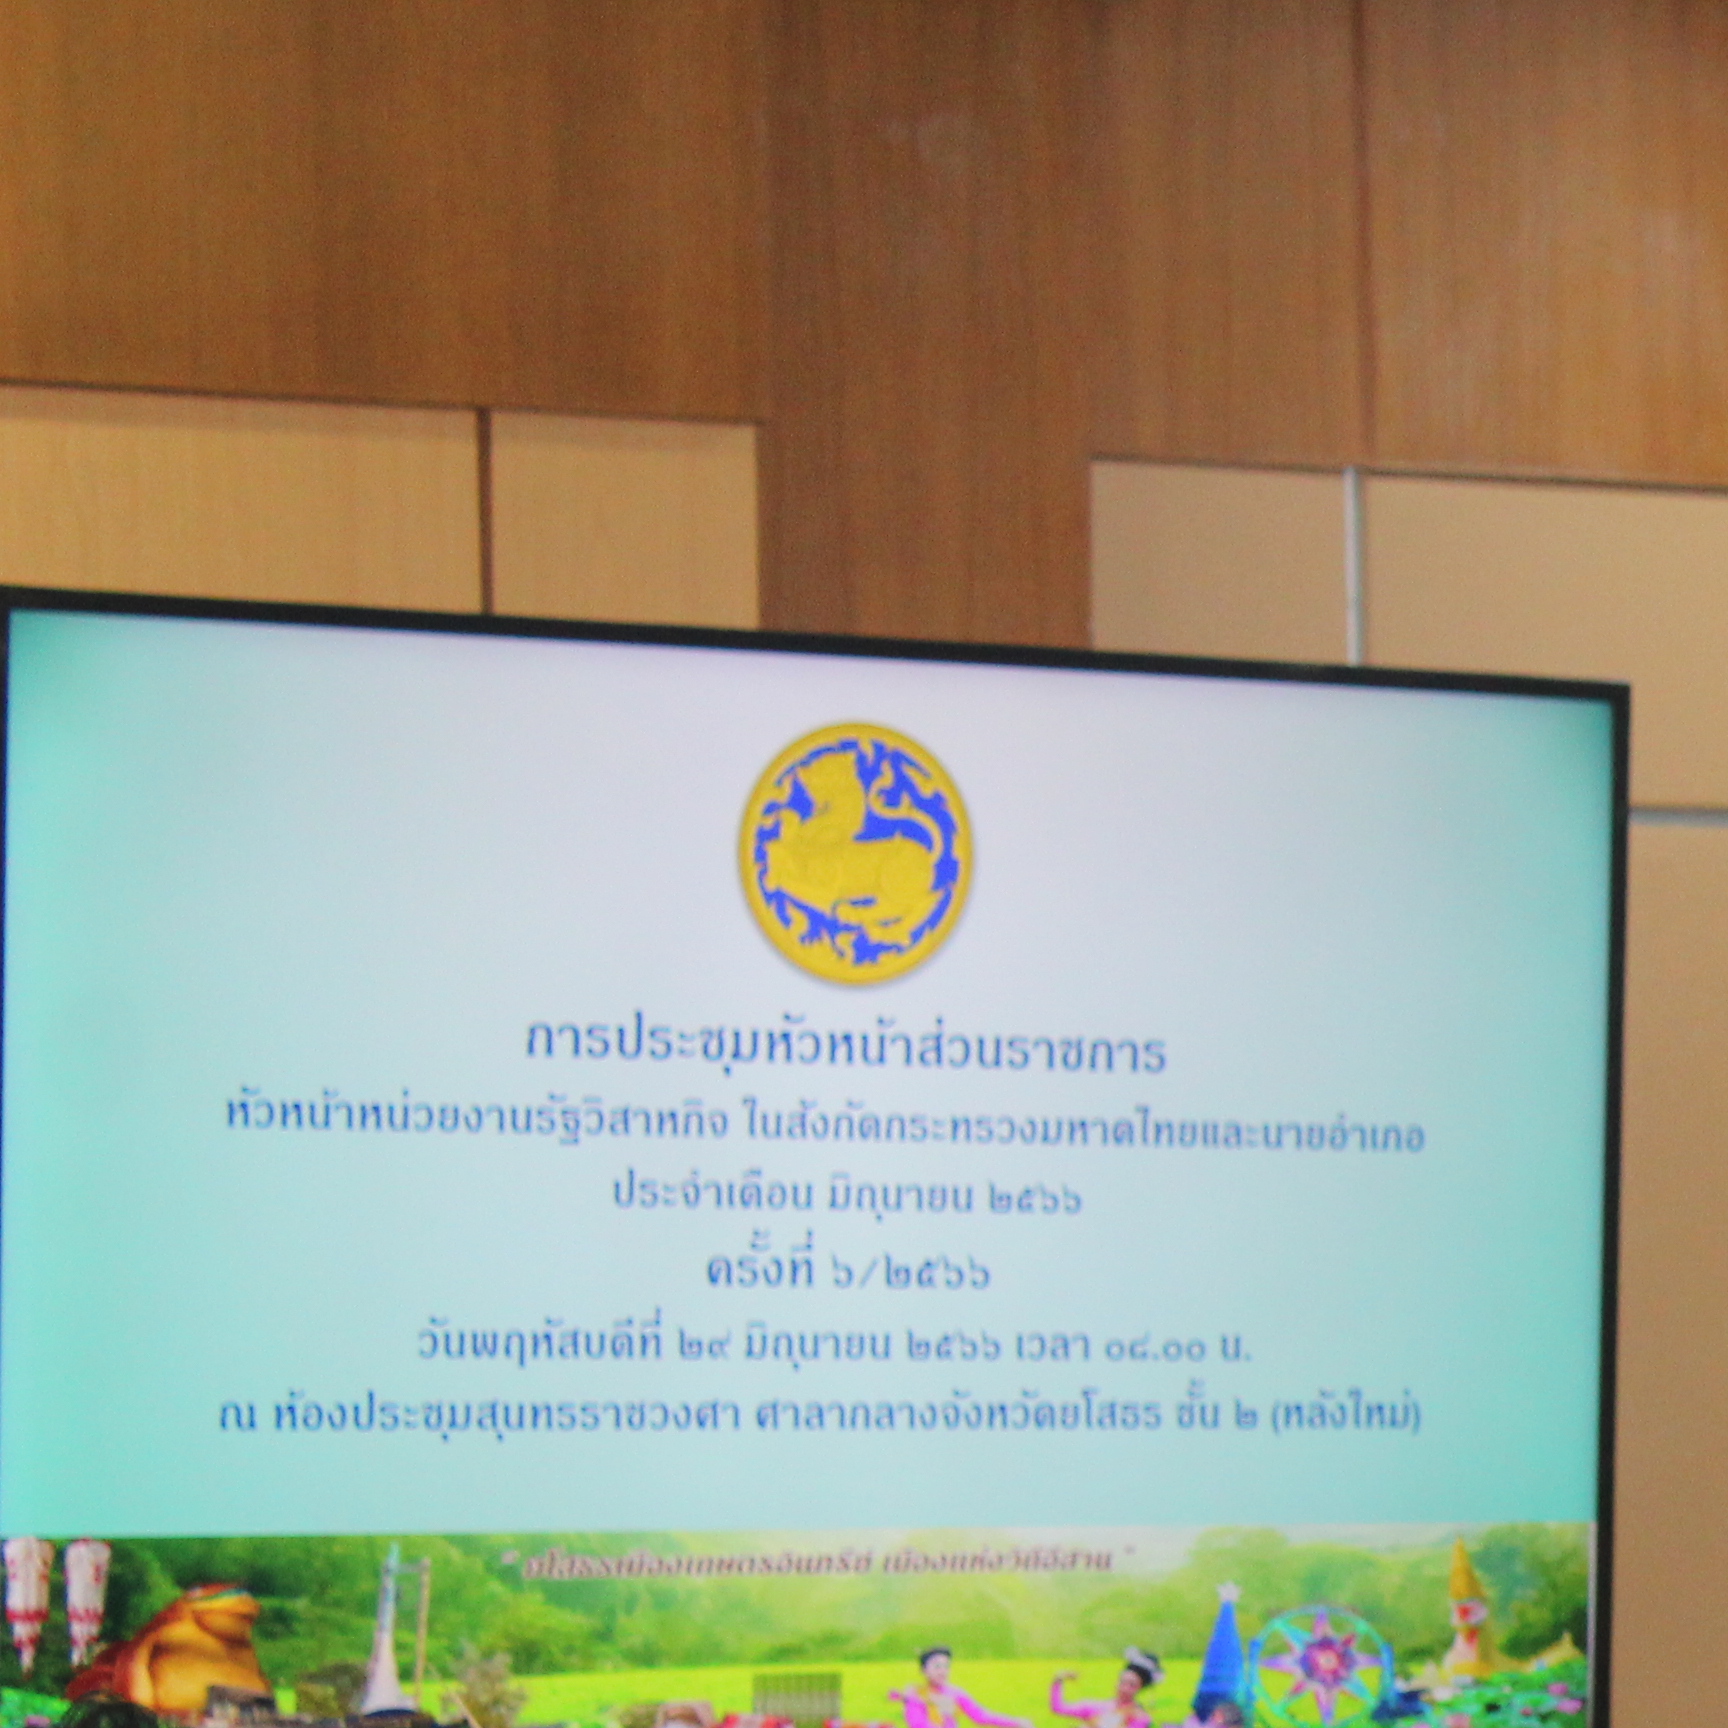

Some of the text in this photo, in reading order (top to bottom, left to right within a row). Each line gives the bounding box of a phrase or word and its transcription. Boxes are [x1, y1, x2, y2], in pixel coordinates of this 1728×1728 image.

[526, 1010, 1167, 1076] การประชุมหัวหน้าส่วนราชการ
[226, 1086, 1426, 1153] หัวหน้าหน่วยงานรัฐวิสาหกิจ ในสังกัดกระทรวงมหาดไทยและนายอำเภอ
[614, 1167, 1083, 1222] ประจำเดือน มิถุนายน ๒๕๖๖
[707, 1229, 992, 1289] ครั้งที่ ๖/๒๕๖๖
[418, 1307, 1252, 1371] วันพฤหัสบดีที่ ๒๙ มิถุนายน ๒๕๖๖ เวลา ๐๘.๐๐ น.
[220, 1379, 1422, 1443] ณ ห้องประชุมสุนทรราชวงศา ศาลากลางจังหวัดยโสธร ชั้น ๒ (หลังใหม่)
